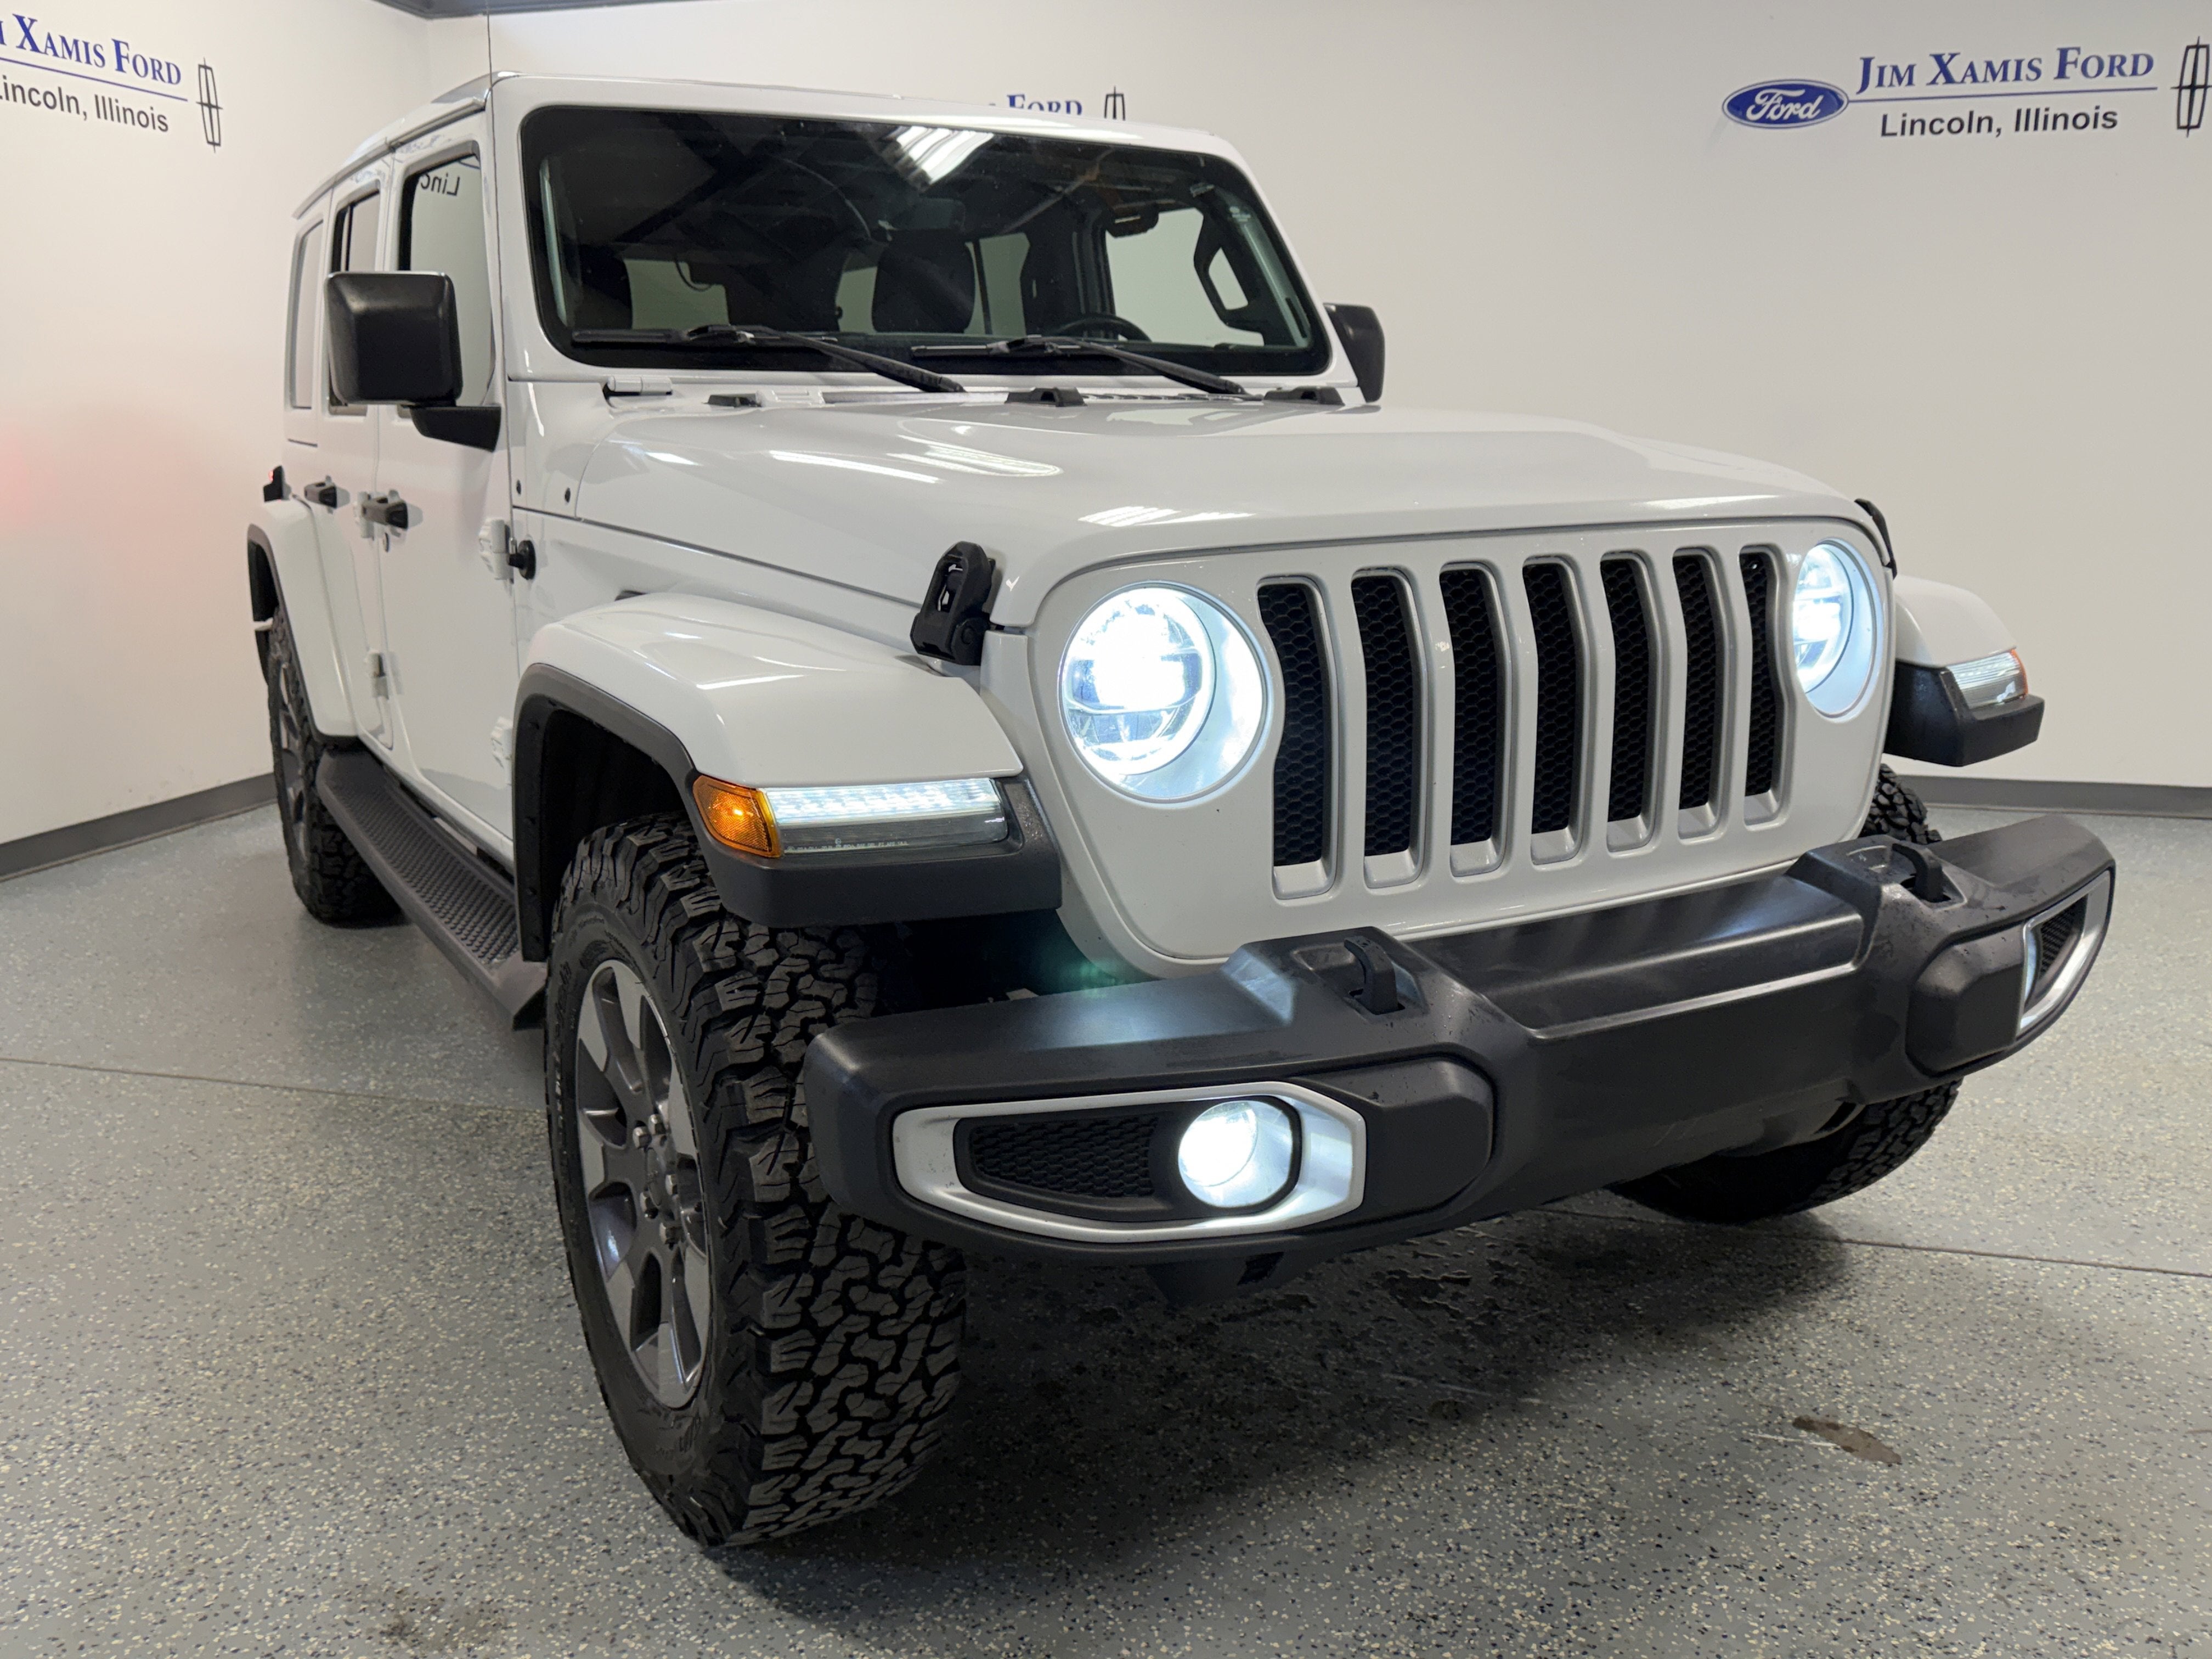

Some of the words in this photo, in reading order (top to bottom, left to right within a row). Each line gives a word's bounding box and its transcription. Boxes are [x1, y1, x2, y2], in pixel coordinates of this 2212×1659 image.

[12, 14, 105, 68] XAMIS
[111, 38, 181, 85] FORD
[1857, 57, 1917, 95] JIM
[1926, 52, 2042, 86] XAMIS
[2053, 47, 2154, 80] FORD
[0, 75, 87, 121] incoln,
[94, 94, 169, 132] Illinois
[1746, 88, 1824, 121] Ford
[1881, 110, 2002, 138] Lincoln,
[2015, 105, 2118, 132] Illinois
